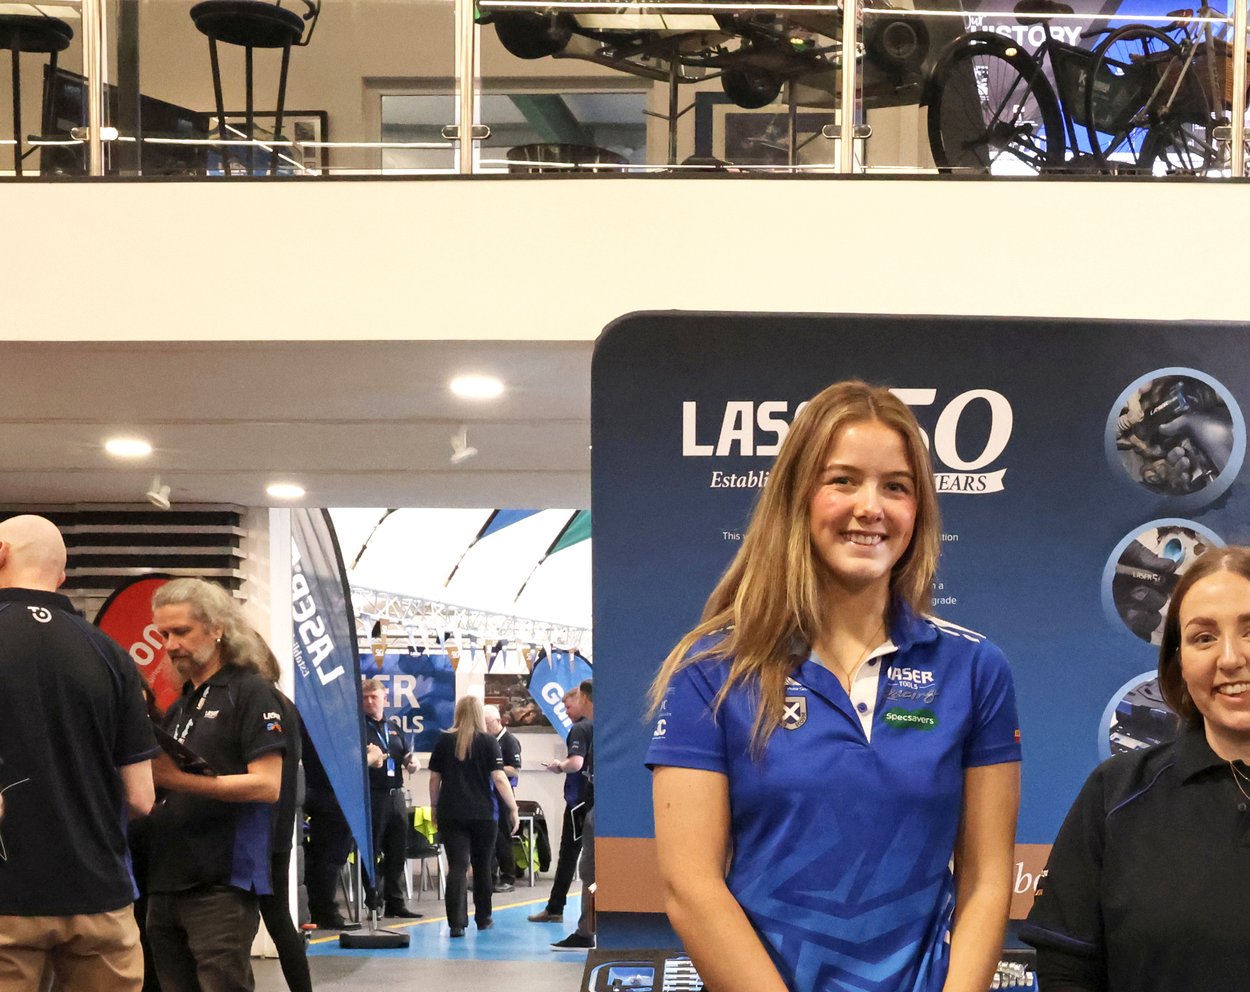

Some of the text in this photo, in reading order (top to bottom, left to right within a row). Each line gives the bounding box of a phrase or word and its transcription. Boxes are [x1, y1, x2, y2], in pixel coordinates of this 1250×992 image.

[971, 26, 1082, 46] STORY
[683, 401, 810, 457] LAS
[710, 471, 768, 488] Establi
[722, 531, 741, 541] This
[899, 681, 918, 690] TOOLS
[886, 713, 934, 725] Specsavers
